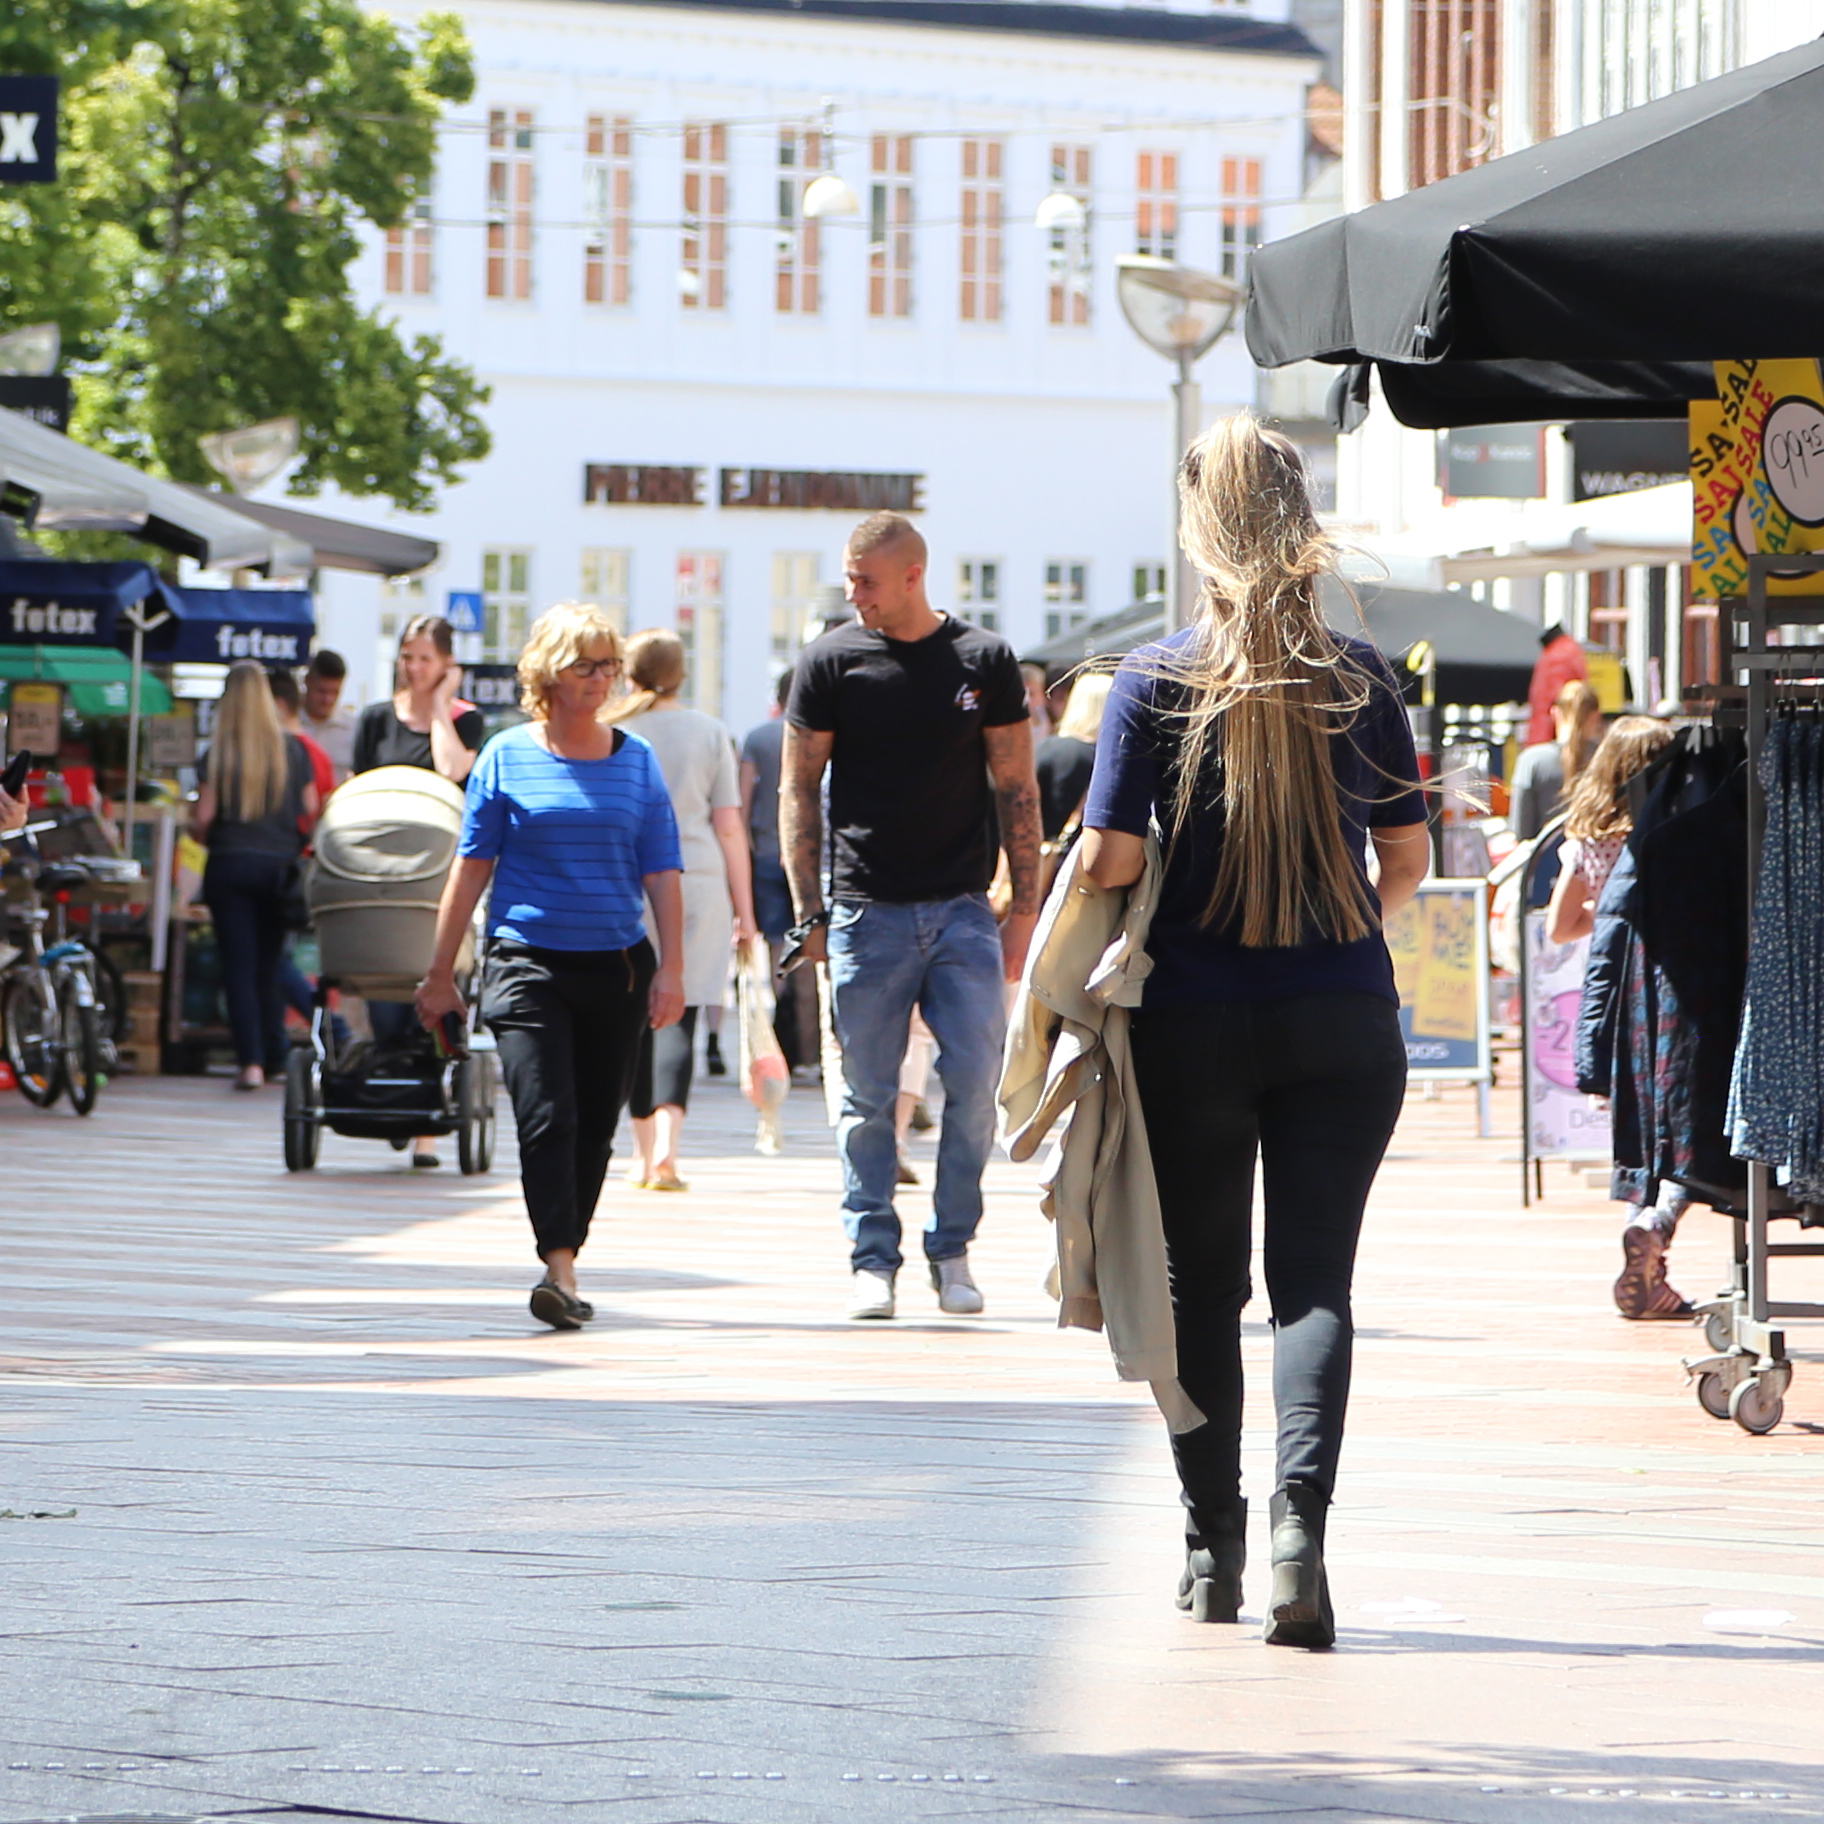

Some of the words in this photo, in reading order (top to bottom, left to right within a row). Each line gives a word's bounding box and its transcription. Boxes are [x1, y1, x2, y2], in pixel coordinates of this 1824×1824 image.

[1721, 359, 1758, 424] SAL
[1735, 379, 1774, 476] SALE
[462, 670, 516, 705] tex
